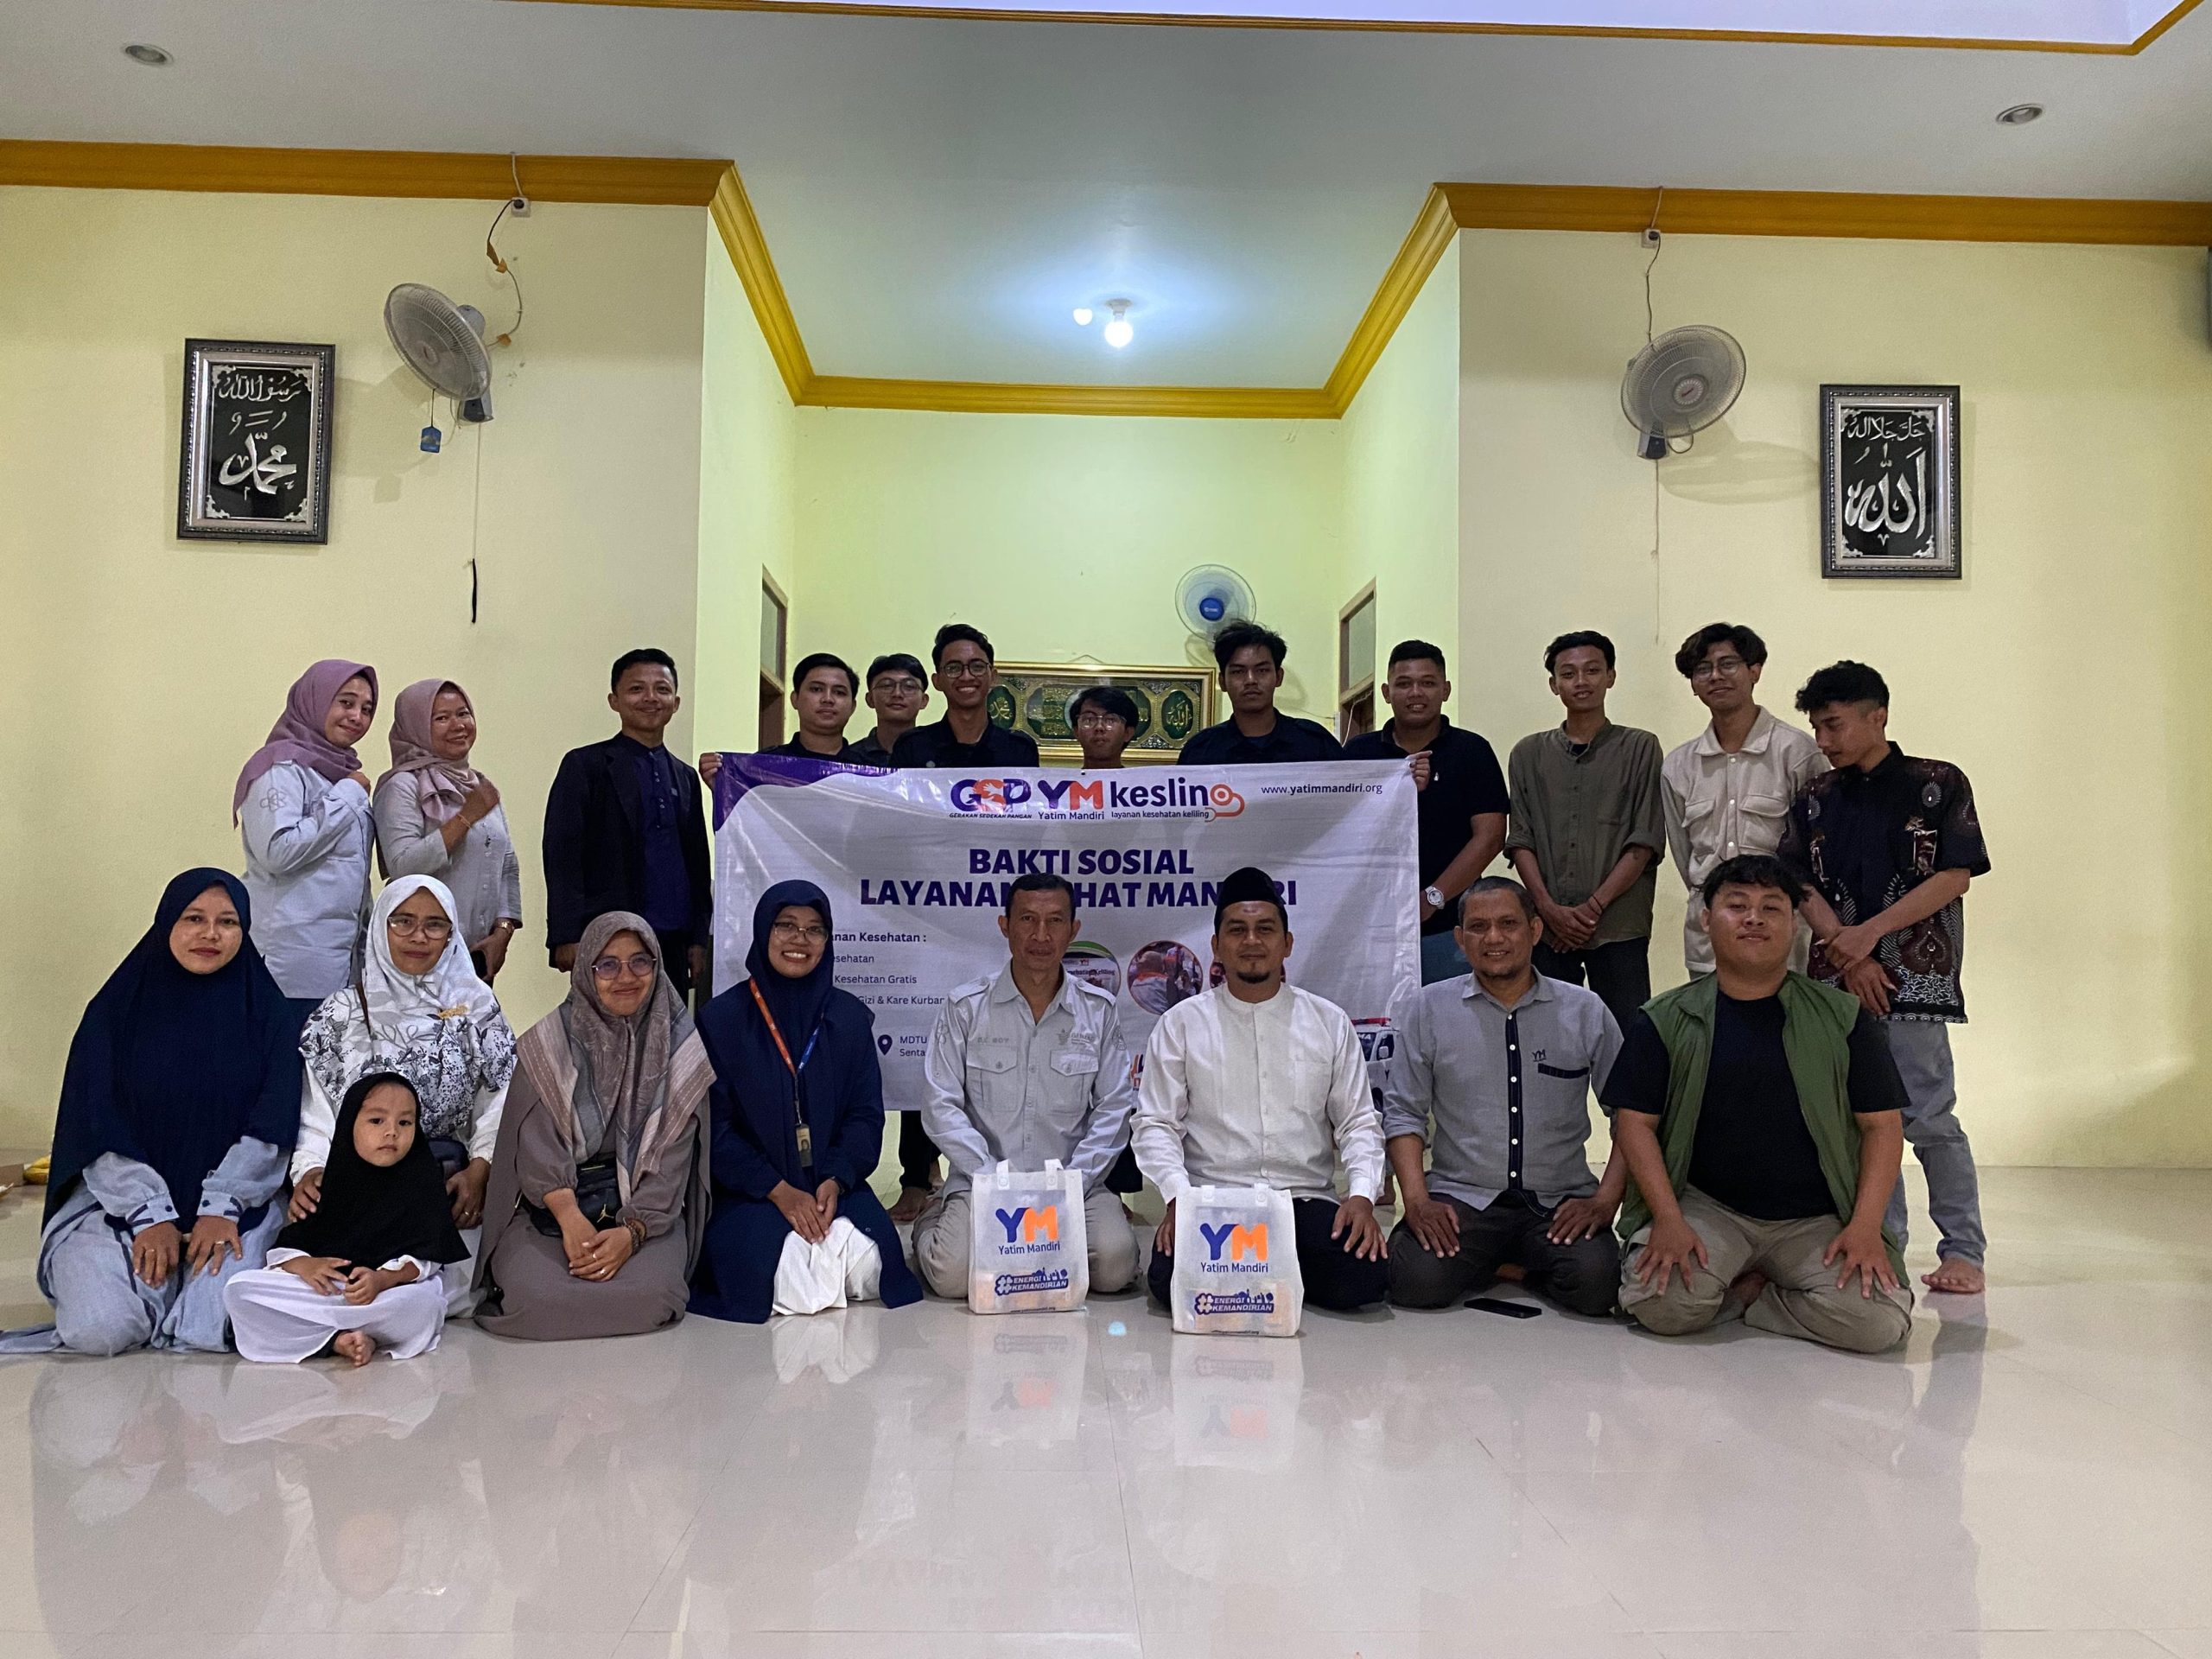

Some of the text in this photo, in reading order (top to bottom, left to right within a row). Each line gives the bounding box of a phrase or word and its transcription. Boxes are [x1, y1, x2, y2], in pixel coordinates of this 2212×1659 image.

[1037, 779, 1104, 810] YM
[1261, 783, 1383, 795] www.yatimmandiri.org
[1038, 810, 1104, 820] Yatim Mandiri
[1182, 810, 1210, 819] keliling
[969, 849, 1194, 875] BAKTI SOSIAL
[1074, 882, 1141, 907] HAT
[1147, 880, 1297, 907] MANRI
[859, 932, 920, 943] Kesehatan
[834, 954, 874, 963] sehatan
[835, 975, 918, 984] Kesehatan Gratis
[877, 996, 885, 1005] &
[887, 996, 909, 1005] Kare
[995, 1205, 1058, 1243] YM
[998, 1240, 1060, 1255] Yatim Mandiri
[1200, 1223, 1268, 1261] YM
[1201, 1262, 1268, 1273] Yatim Mandiri
[1014, 1275, 1042, 1284] ENERGI
[1012, 1280, 1067, 1291] KEMANDIRIAN
